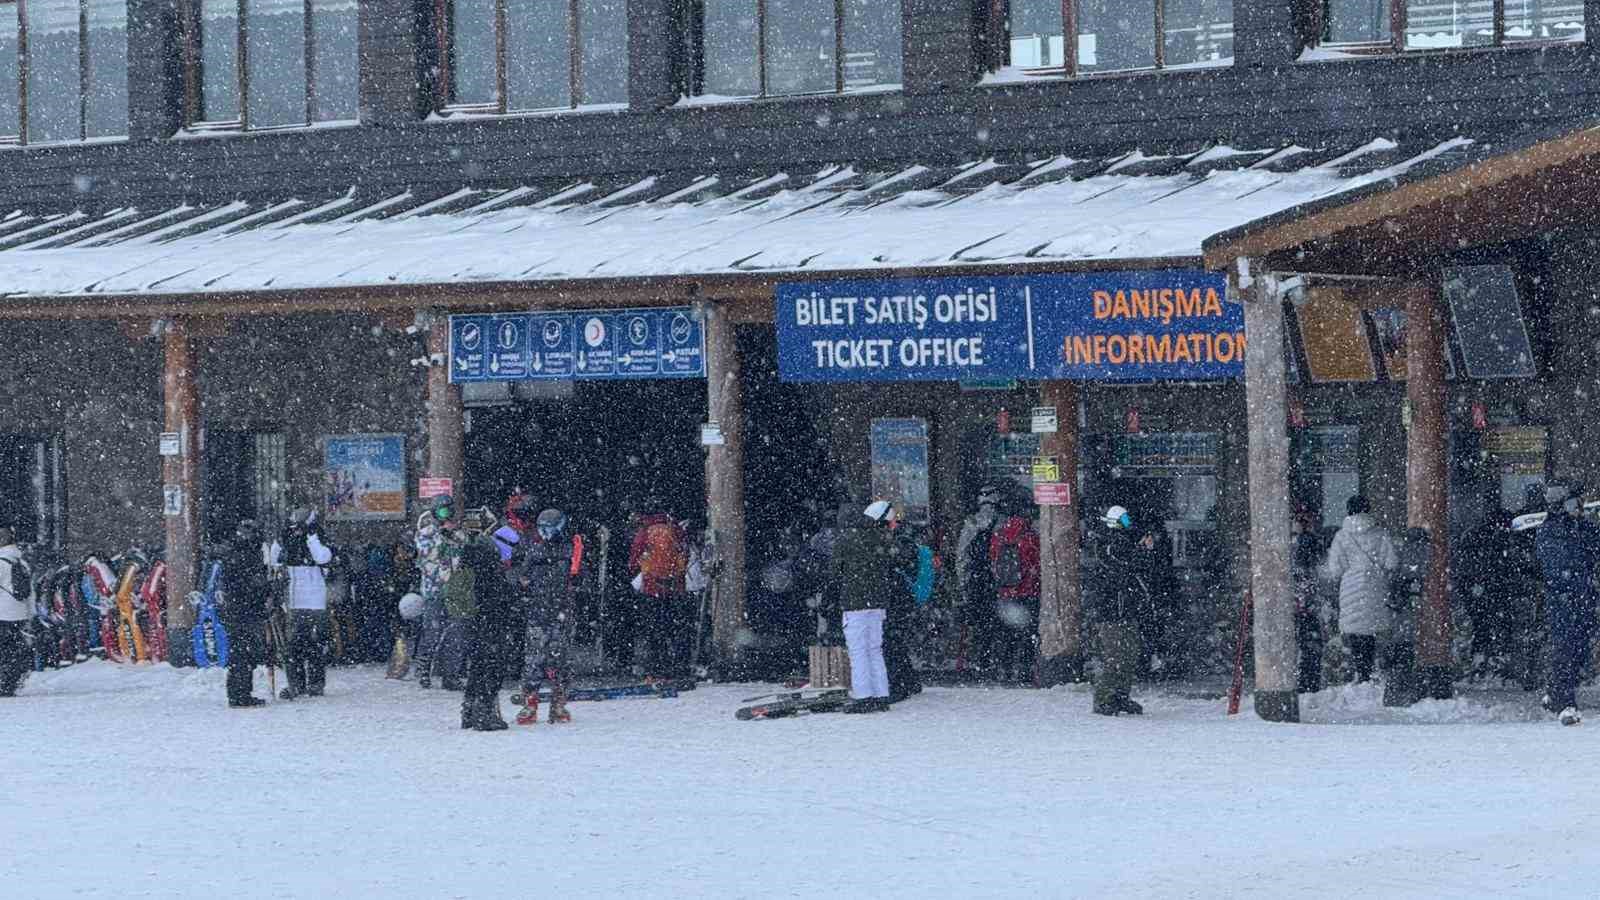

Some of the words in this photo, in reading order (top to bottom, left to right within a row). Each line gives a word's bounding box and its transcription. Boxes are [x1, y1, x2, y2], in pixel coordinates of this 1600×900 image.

[796, 291, 857, 326] BİLET
[864, 294, 928, 330] SATIŞ
[934, 286, 997, 323] OFİSİ
[1092, 287, 1223, 325] DANIŞMA
[812, 339, 893, 368] TICKET
[899, 337, 983, 367] OFFICE
[1063, 331, 1248, 366] INFORMATION
